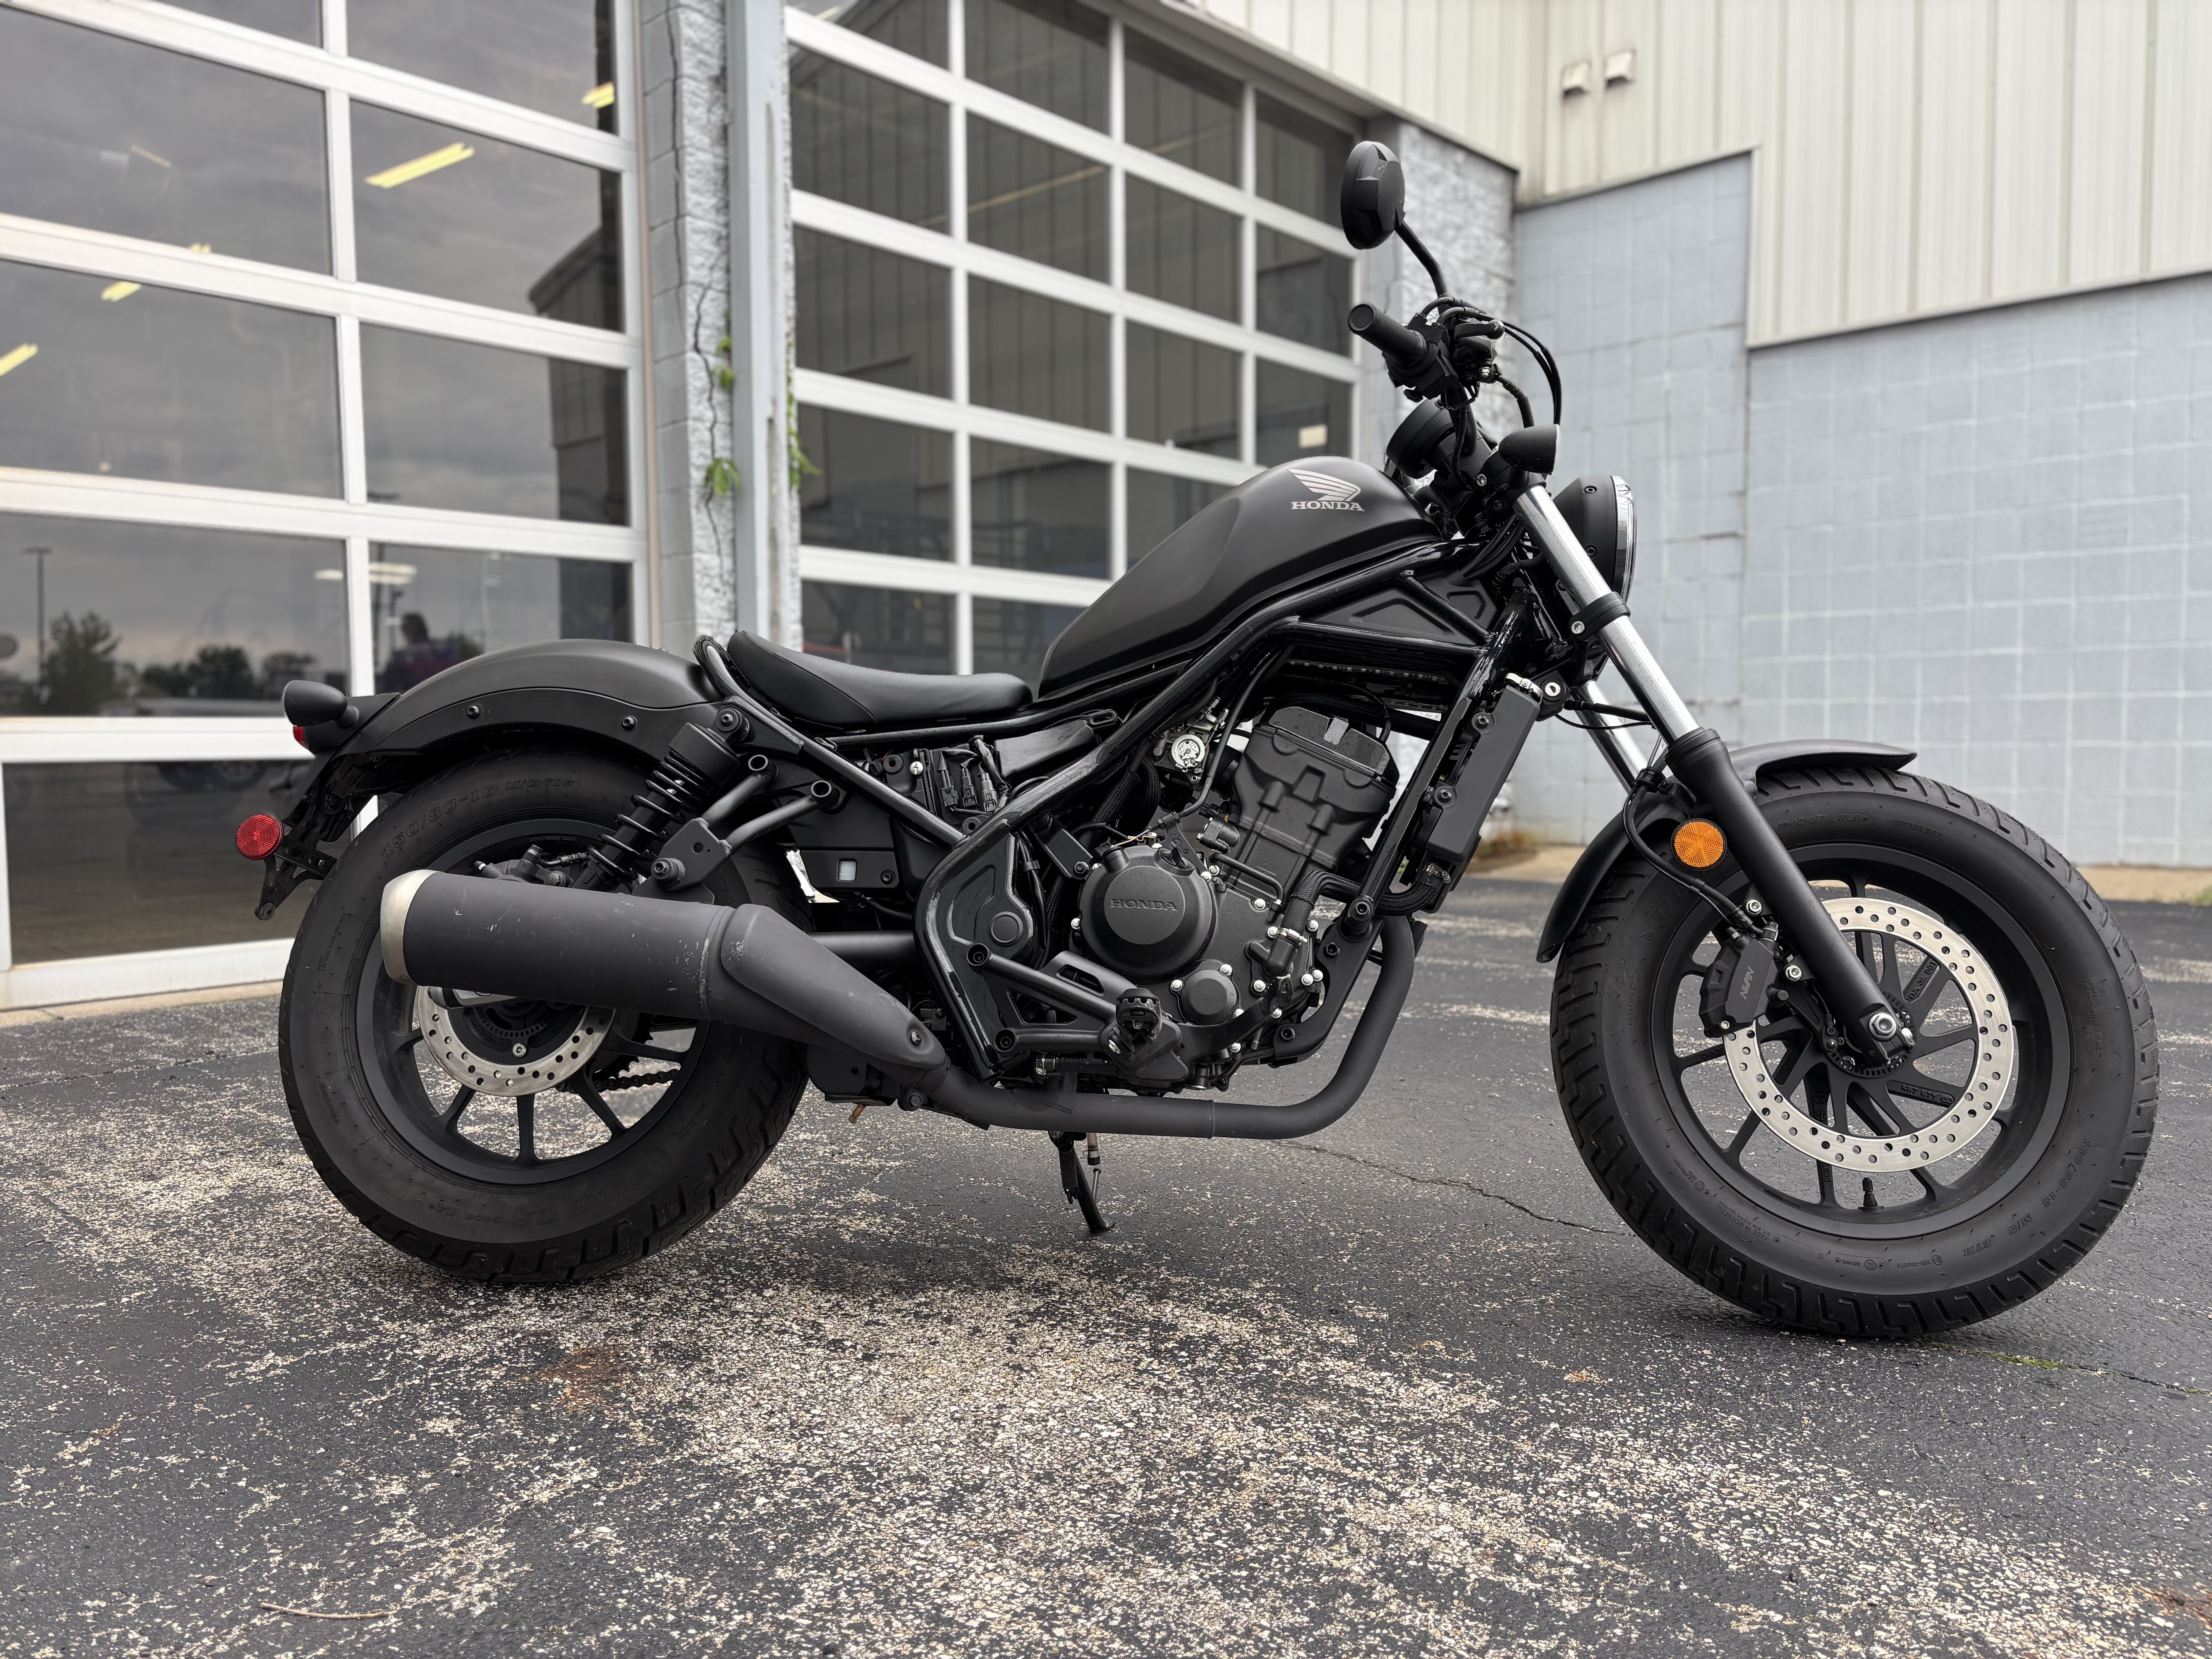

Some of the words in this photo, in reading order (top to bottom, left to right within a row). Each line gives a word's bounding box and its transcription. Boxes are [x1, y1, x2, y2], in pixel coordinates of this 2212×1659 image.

[1291, 501, 1365, 512] HONDA
[380, 784, 498, 860] 150/80-16
[504, 779, 538, 790] M/C
[544, 778, 575, 790] 71H
[1110, 899, 1178, 911] HONDA
[1740, 966, 1755, 1000] NISSIN
[2040, 1137, 2093, 1208] 130/90-16
[509, 1158, 657, 1227] DUNLOP
[1716, 1204, 1745, 1227] INDONESIA
[2005, 1212, 2035, 1236] M/C
[1751, 1229, 1769, 1241] MADE
